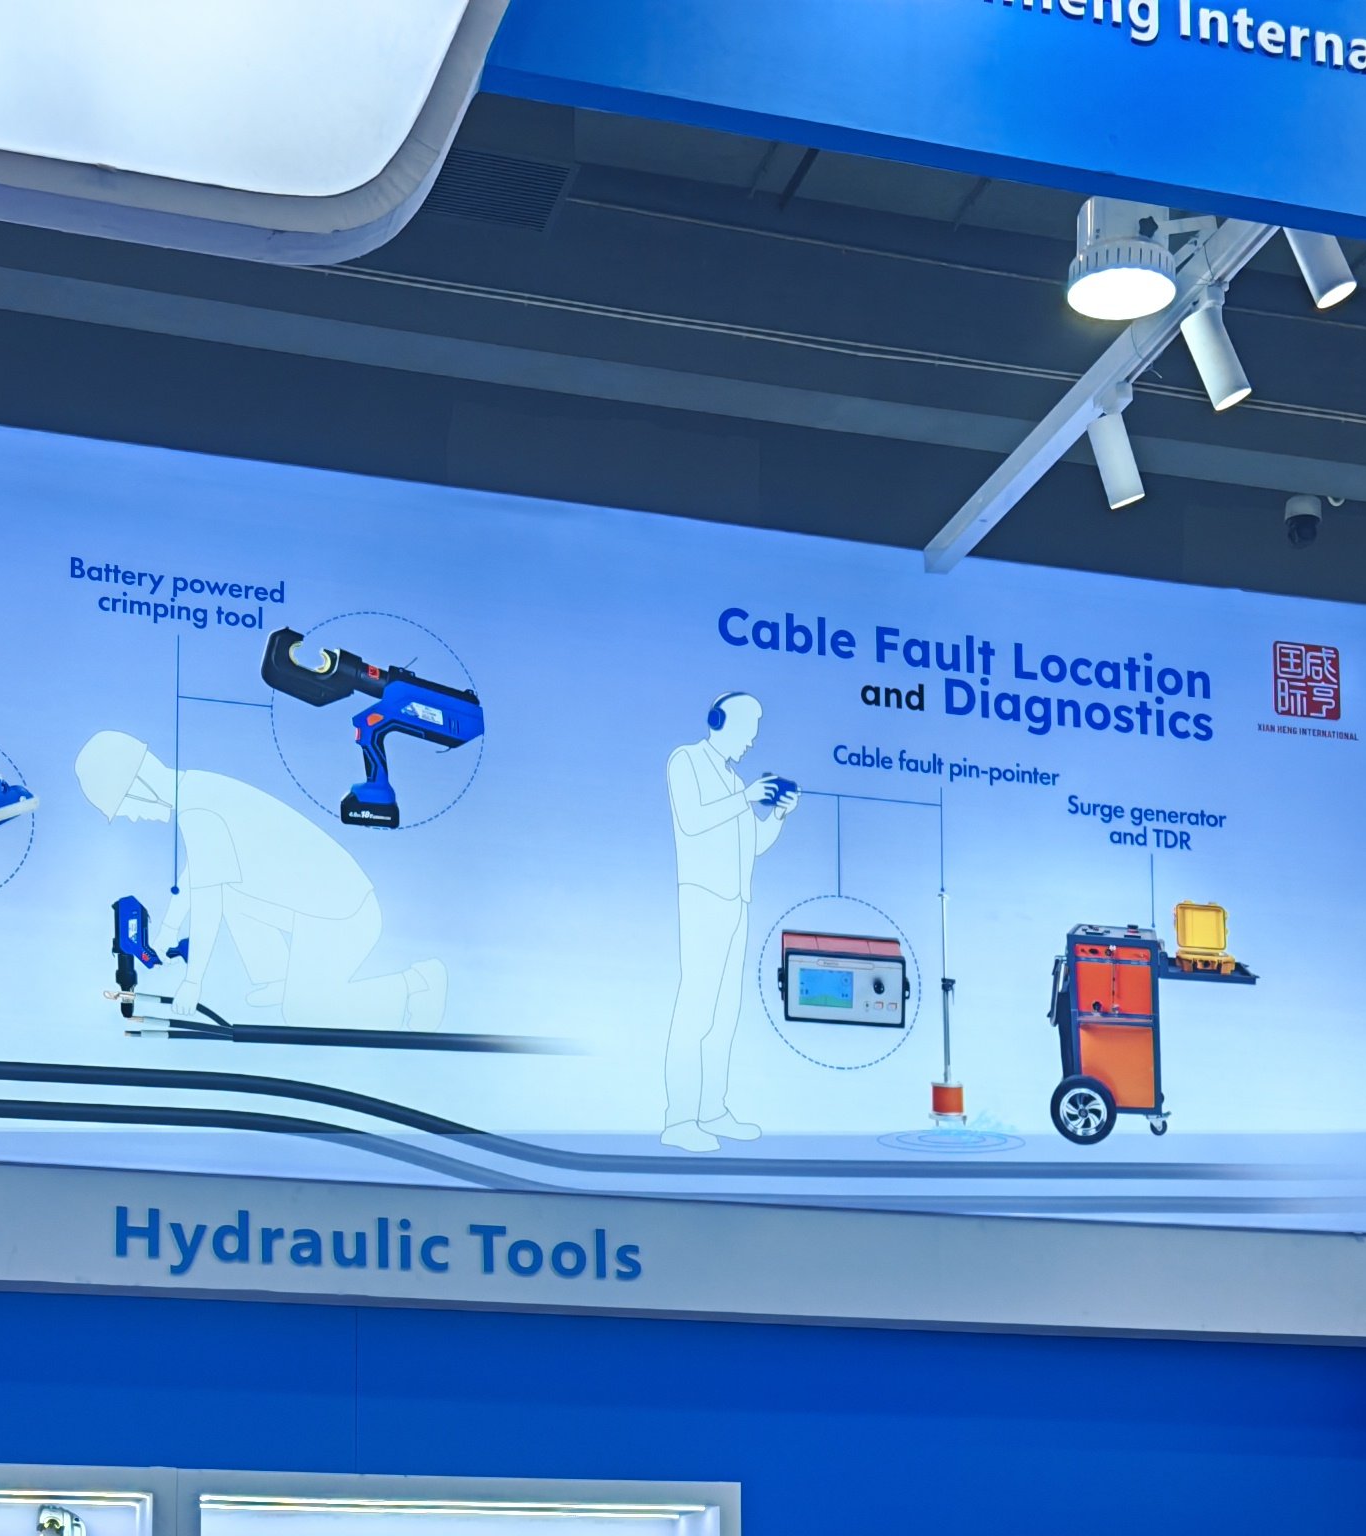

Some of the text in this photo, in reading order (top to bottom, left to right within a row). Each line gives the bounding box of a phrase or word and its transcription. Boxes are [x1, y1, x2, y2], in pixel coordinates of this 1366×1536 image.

[69, 556, 285, 604] Battery powered
[97, 590, 264, 630] crimping tool
[717, 607, 1212, 700] Cable Fault Location
[860, 677, 1215, 742] and Diagnostics
[1257, 723, 1359, 741] XIAN HENG INTERNATIONAL
[833, 744, 1060, 789] Cable fault pin-pointer
[1067, 795, 1227, 831] Surge generator
[1109, 827, 1192, 851] and TDR
[114, 1205, 643, 1282] Hydraulic Tools
